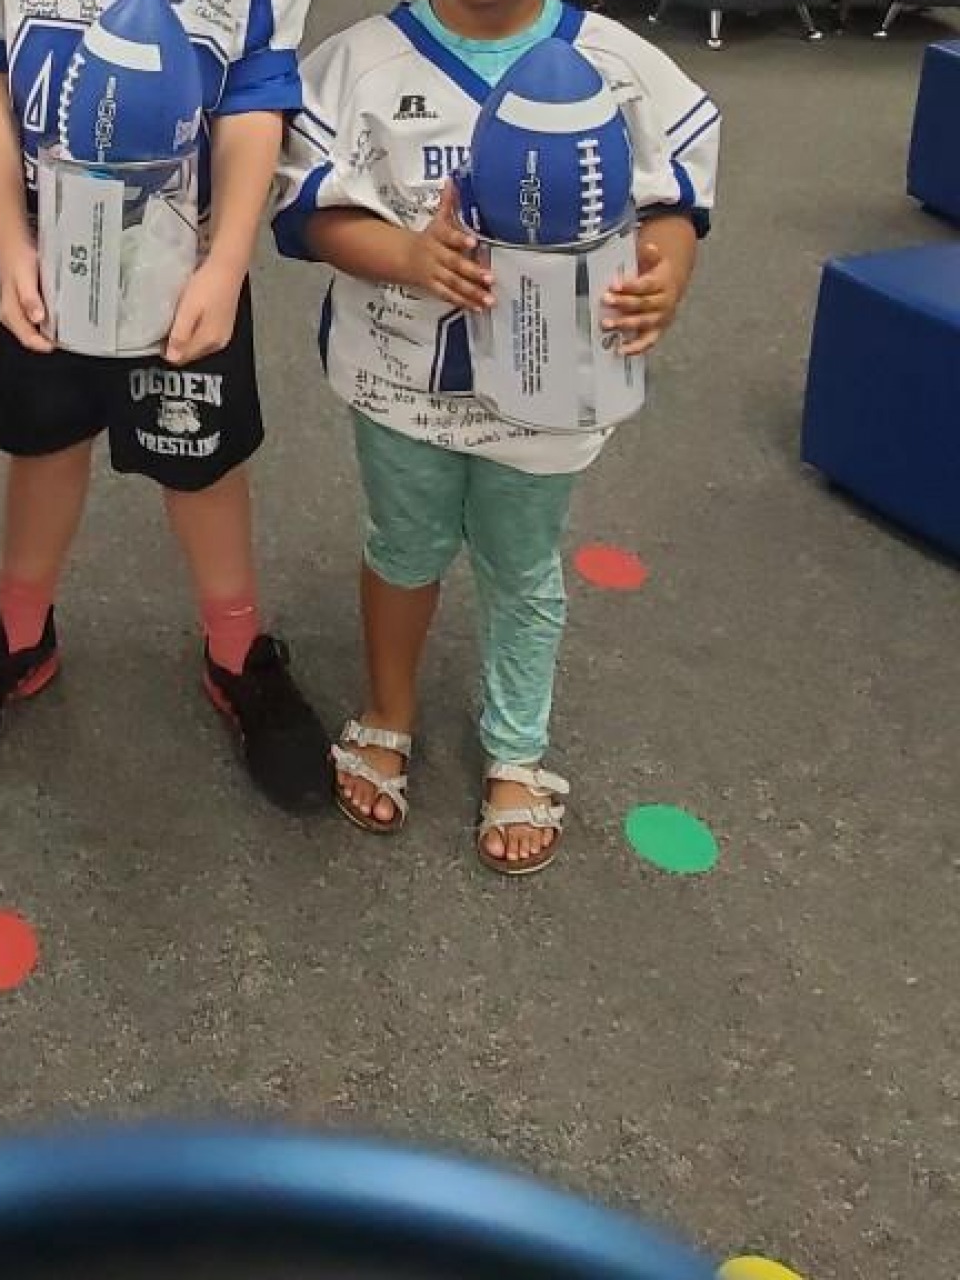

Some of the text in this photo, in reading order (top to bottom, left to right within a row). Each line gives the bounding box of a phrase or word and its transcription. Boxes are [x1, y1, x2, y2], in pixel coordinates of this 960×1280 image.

[399, 94, 427, 112] R
[70, 242, 89, 277] $5
[128, 366, 224, 408] OGDEN
